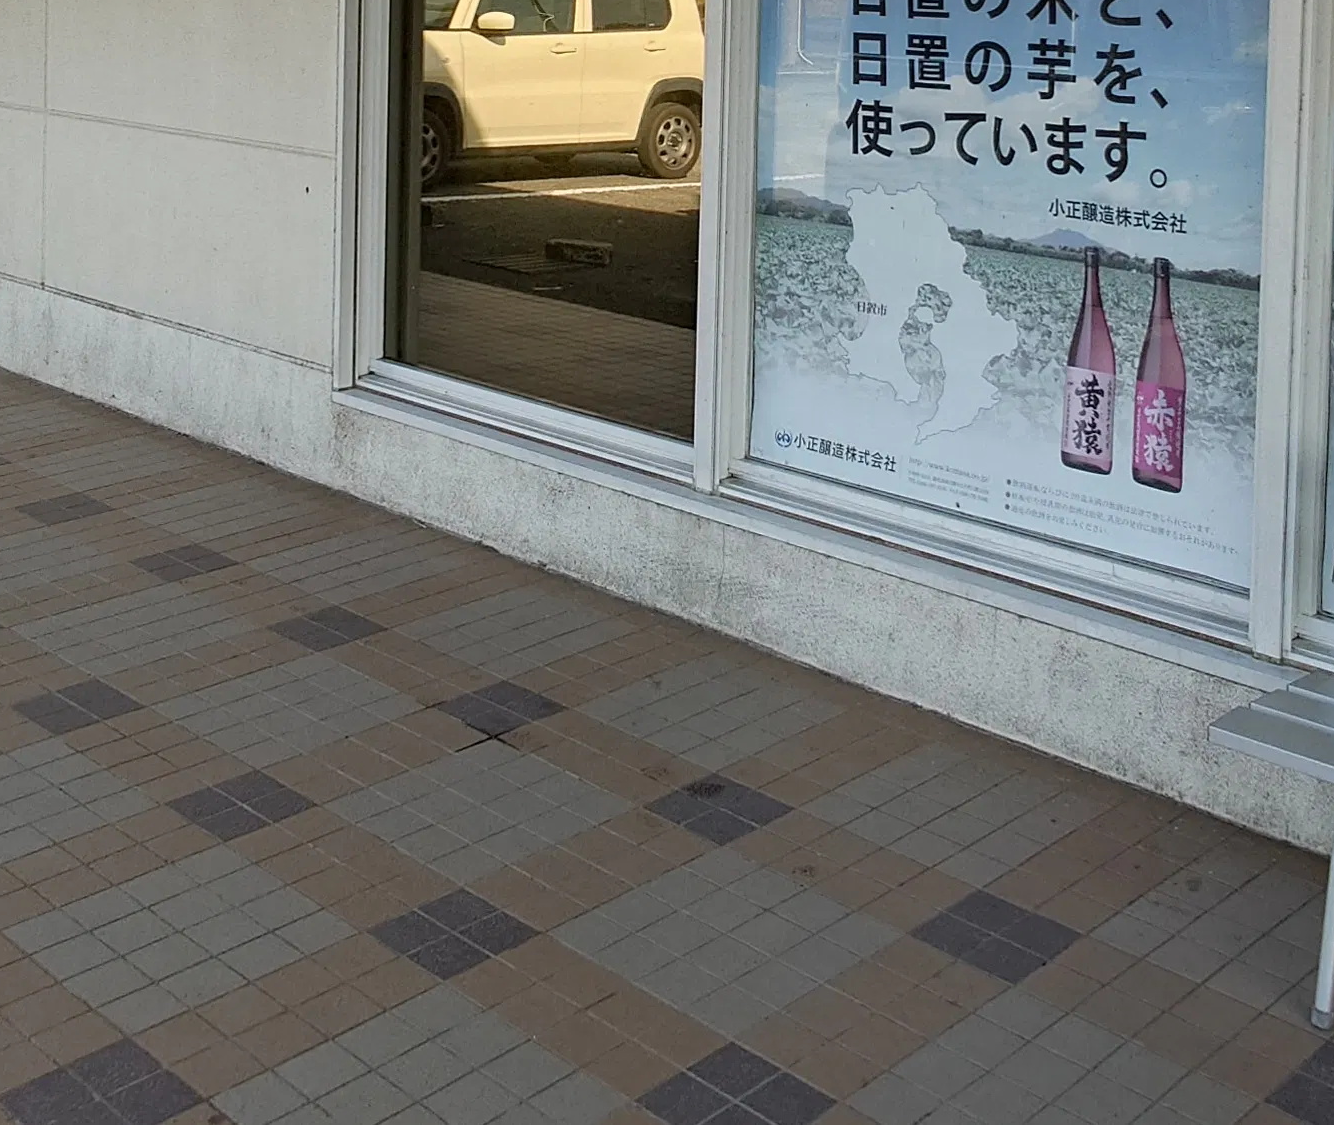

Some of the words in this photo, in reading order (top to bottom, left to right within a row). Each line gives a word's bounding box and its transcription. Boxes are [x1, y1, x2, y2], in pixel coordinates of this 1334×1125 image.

[852, 33, 1169, 108] 日置の芋を、
[846, 99, 1168, 188] 使っています。
[1048, 198, 1188, 235] 小正醸造株式会社
[794, 433, 897, 473] 小正醸造株式会社
